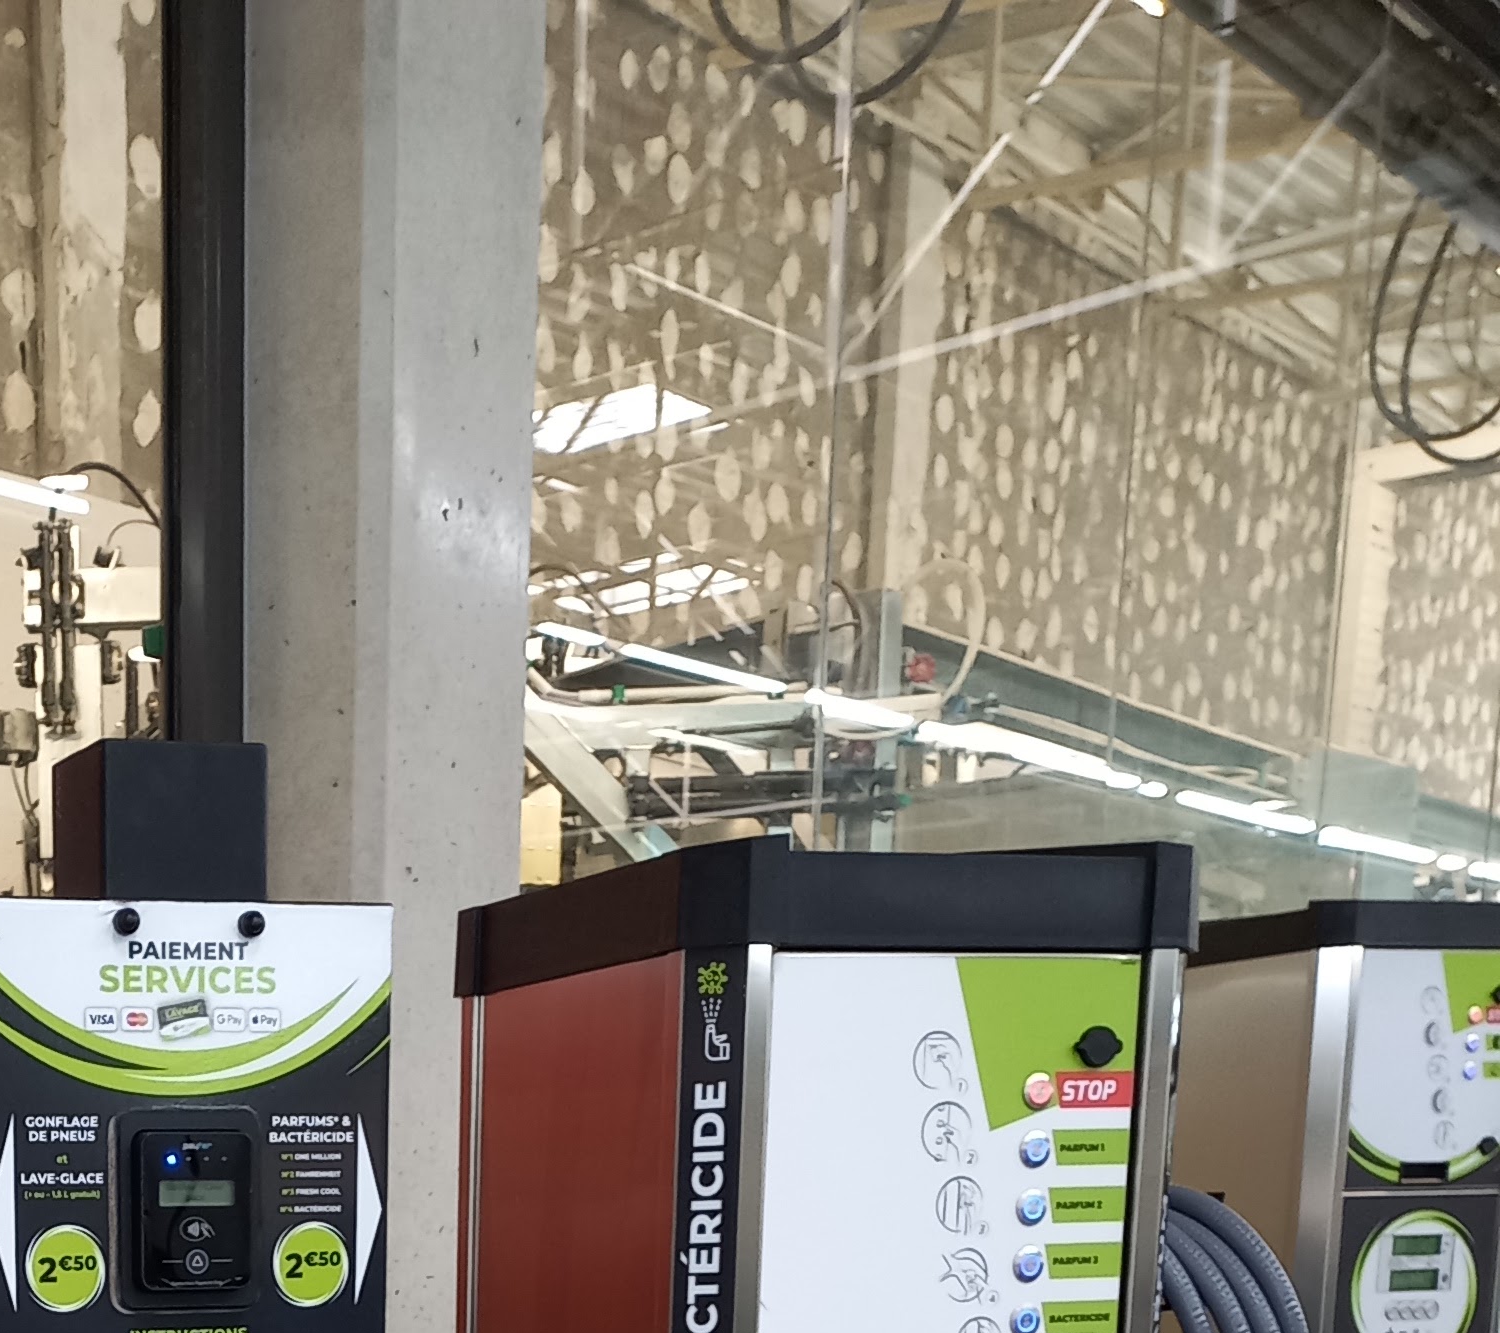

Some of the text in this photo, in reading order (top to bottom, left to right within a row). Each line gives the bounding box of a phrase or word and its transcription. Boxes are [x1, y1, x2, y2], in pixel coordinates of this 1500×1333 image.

[128, 940, 249, 960] PAIEMENT
[99, 964, 276, 994] SERVICES
[89, 1014, 115, 1025] VISA
[261, 1014, 277, 1027] Pay
[1061, 1079, 1117, 1101] STOP
[24, 1115, 99, 1128] GONFLAGE
[341, 1115, 351, 1127] &
[28, 1130, 96, 1142] DE PNEUS
[269, 1129, 355, 1143] BACTÉRICIDE
[56, 1154, 68, 1164] et
[20, 1172, 104, 1184] LAVE-GLACE
